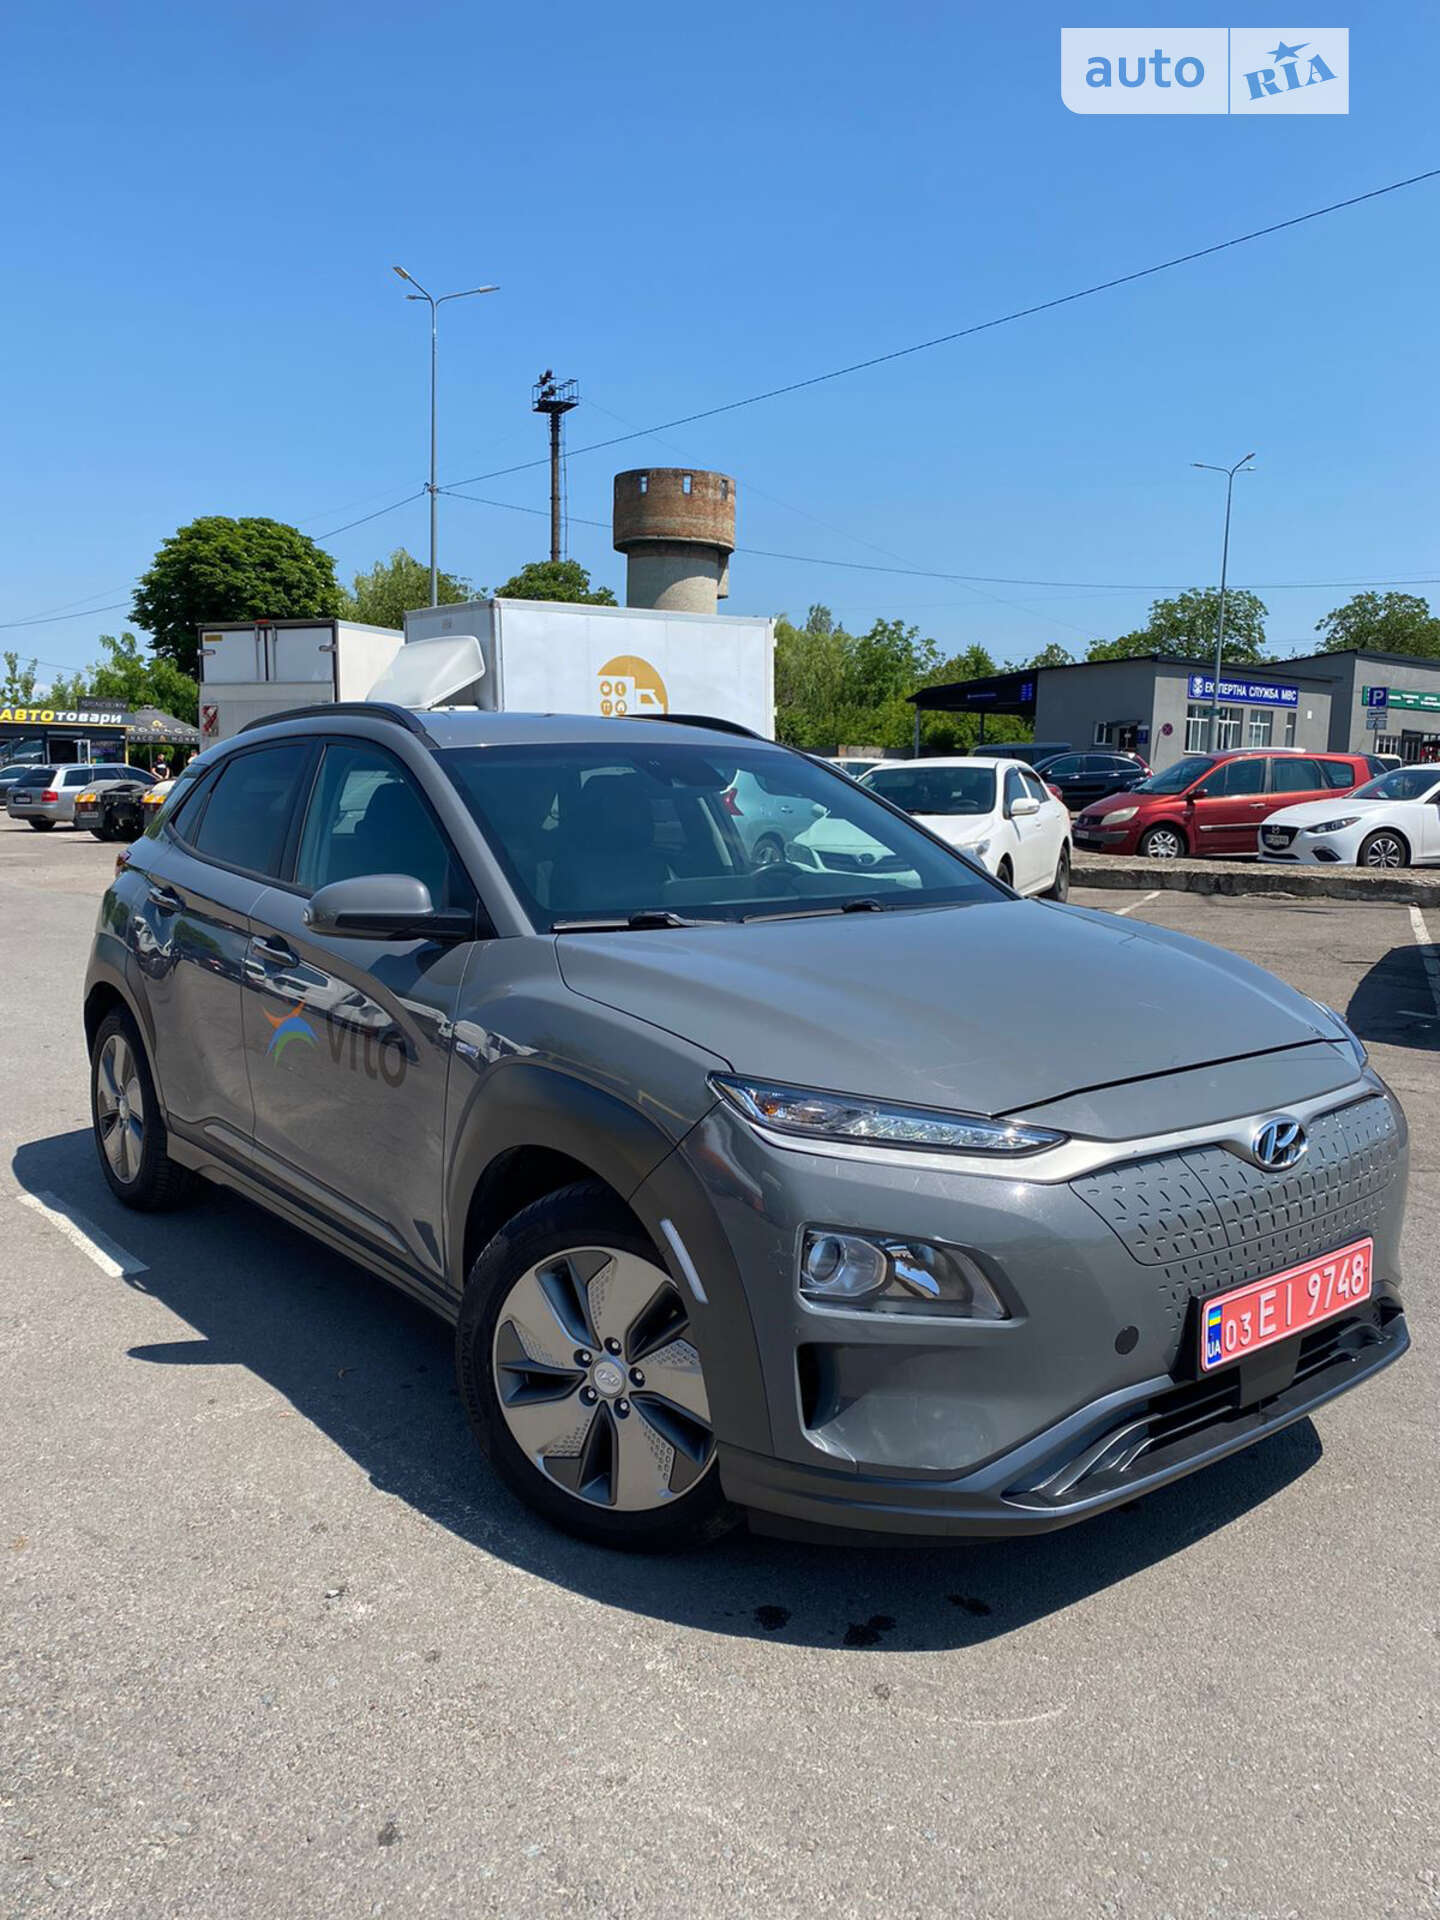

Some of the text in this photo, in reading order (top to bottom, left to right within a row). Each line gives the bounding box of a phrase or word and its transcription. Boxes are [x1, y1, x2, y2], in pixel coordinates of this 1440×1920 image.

[1204, 681, 1297, 702] ЕКПЕРТНА СЛУЖБА МВС
[1372, 690, 1385, 705] P
[0, 708, 122, 725] АВТОтовари
[1307, 1254, 1365, 1317] 9748
[1207, 1341, 1222, 1358] UA
